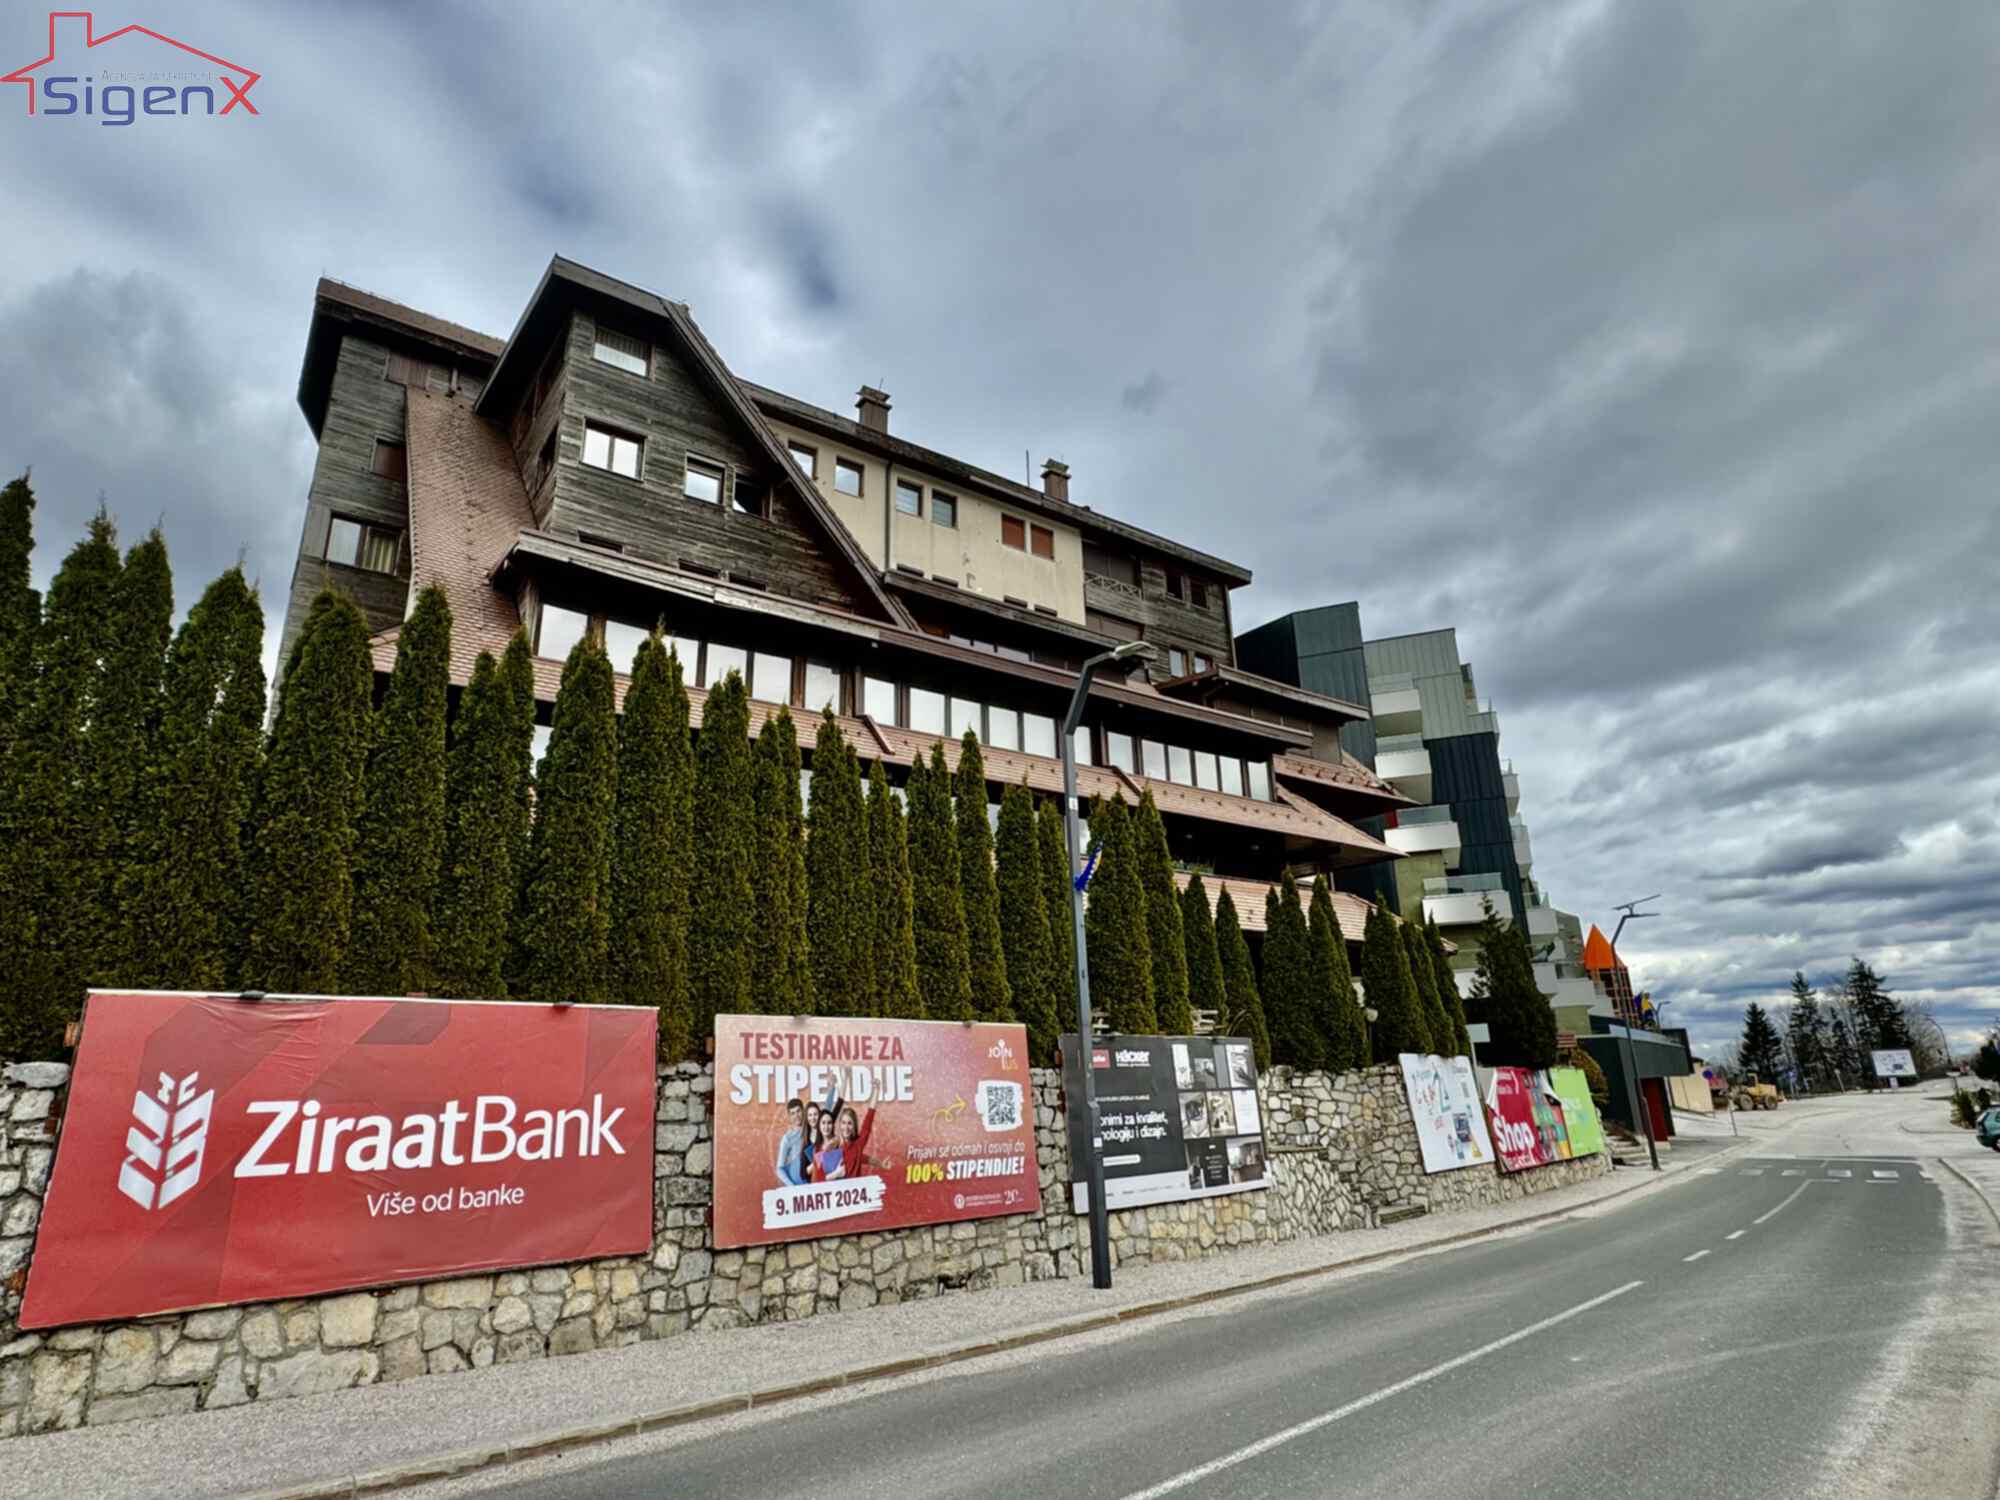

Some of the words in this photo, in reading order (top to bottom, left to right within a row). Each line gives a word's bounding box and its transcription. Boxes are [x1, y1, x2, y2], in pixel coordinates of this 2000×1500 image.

[740, 1032, 872, 1061] TESTIRANJE
[879, 1037, 904, 1061] ZA
[1124, 1115, 1135, 1125] za
[233, 1093, 627, 1179] ZiraatBank
[1493, 1114, 1537, 1162] Shop
[906, 1163, 944, 1184] 100%
[946, 1156, 1025, 1180] STIPENDIJE!
[367, 1193, 415, 1218] Više
[422, 1188, 453, 1214] od
[458, 1184, 525, 1208] banke
[776, 1198, 789, 1216] 9.
[793, 1191, 832, 1213] MART
[834, 1187, 872, 1207] 2024.
